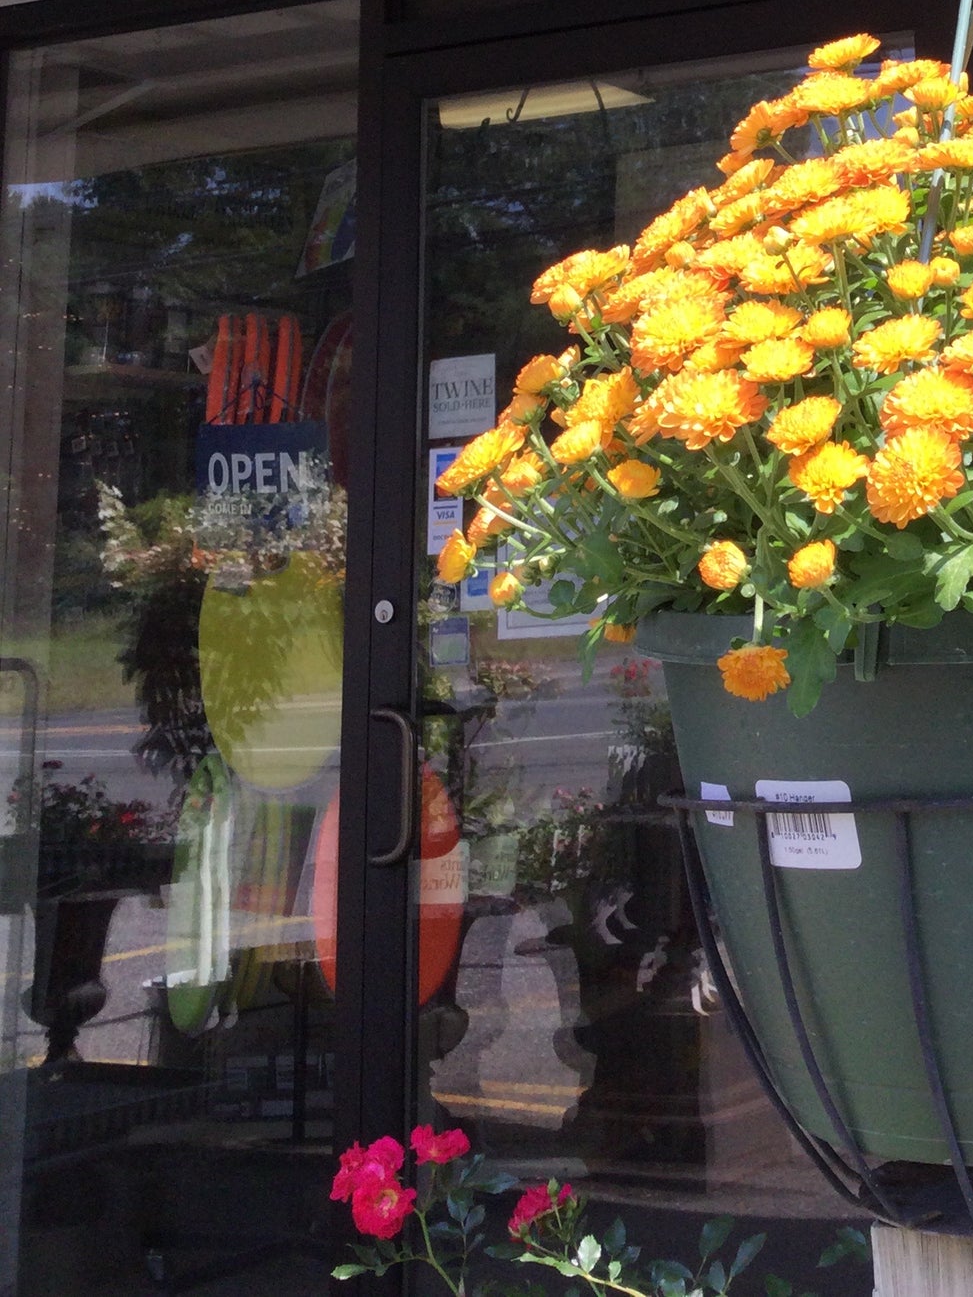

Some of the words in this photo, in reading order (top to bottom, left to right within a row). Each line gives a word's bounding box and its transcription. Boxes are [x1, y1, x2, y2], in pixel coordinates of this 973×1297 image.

[432, 377, 493, 400] TWINE
[208, 451, 308, 495] OPEN
[208, 503, 237, 515] COME
[240, 503, 252, 515] IN
[436, 511, 455, 520] VISA
